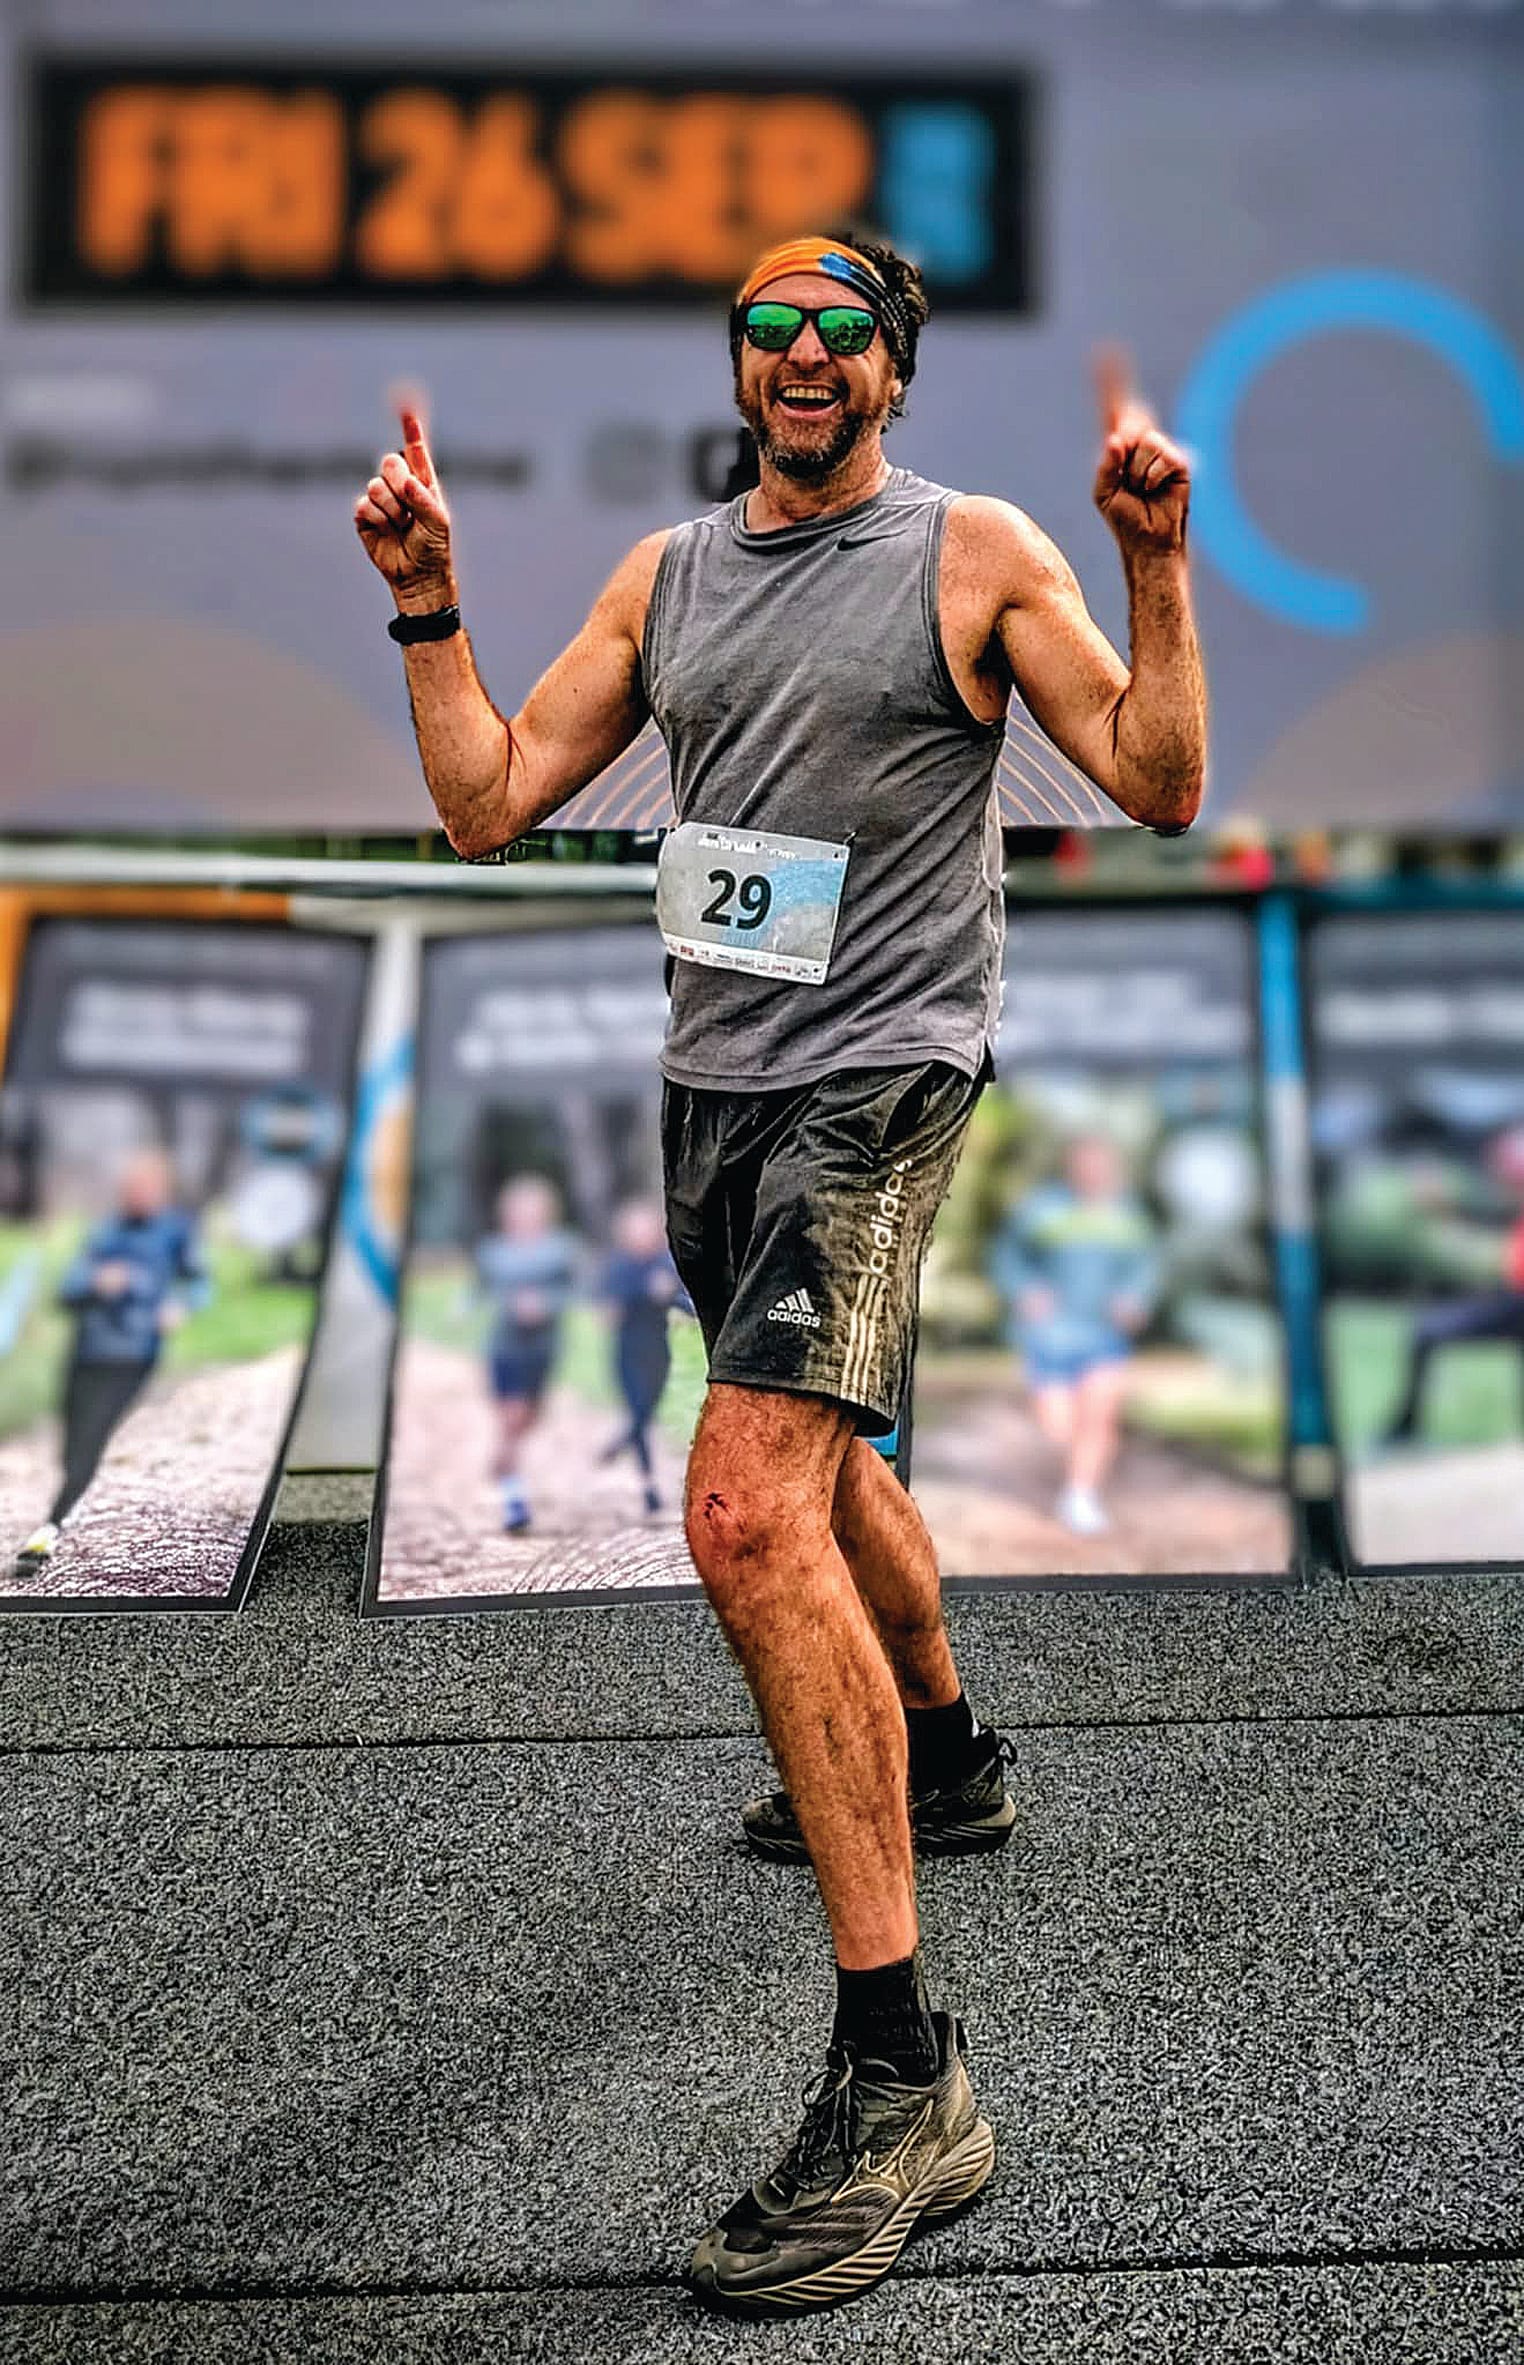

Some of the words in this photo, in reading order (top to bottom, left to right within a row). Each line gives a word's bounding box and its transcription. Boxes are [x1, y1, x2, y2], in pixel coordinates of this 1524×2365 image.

[84, 84, 346, 280] FRI
[356, 88, 556, 283] 26
[561, 91, 873, 283] SEP
[701, 869, 771, 930] 29
[869, 1159, 912, 1274] adidas
[767, 1308, 821, 1328] adidas
